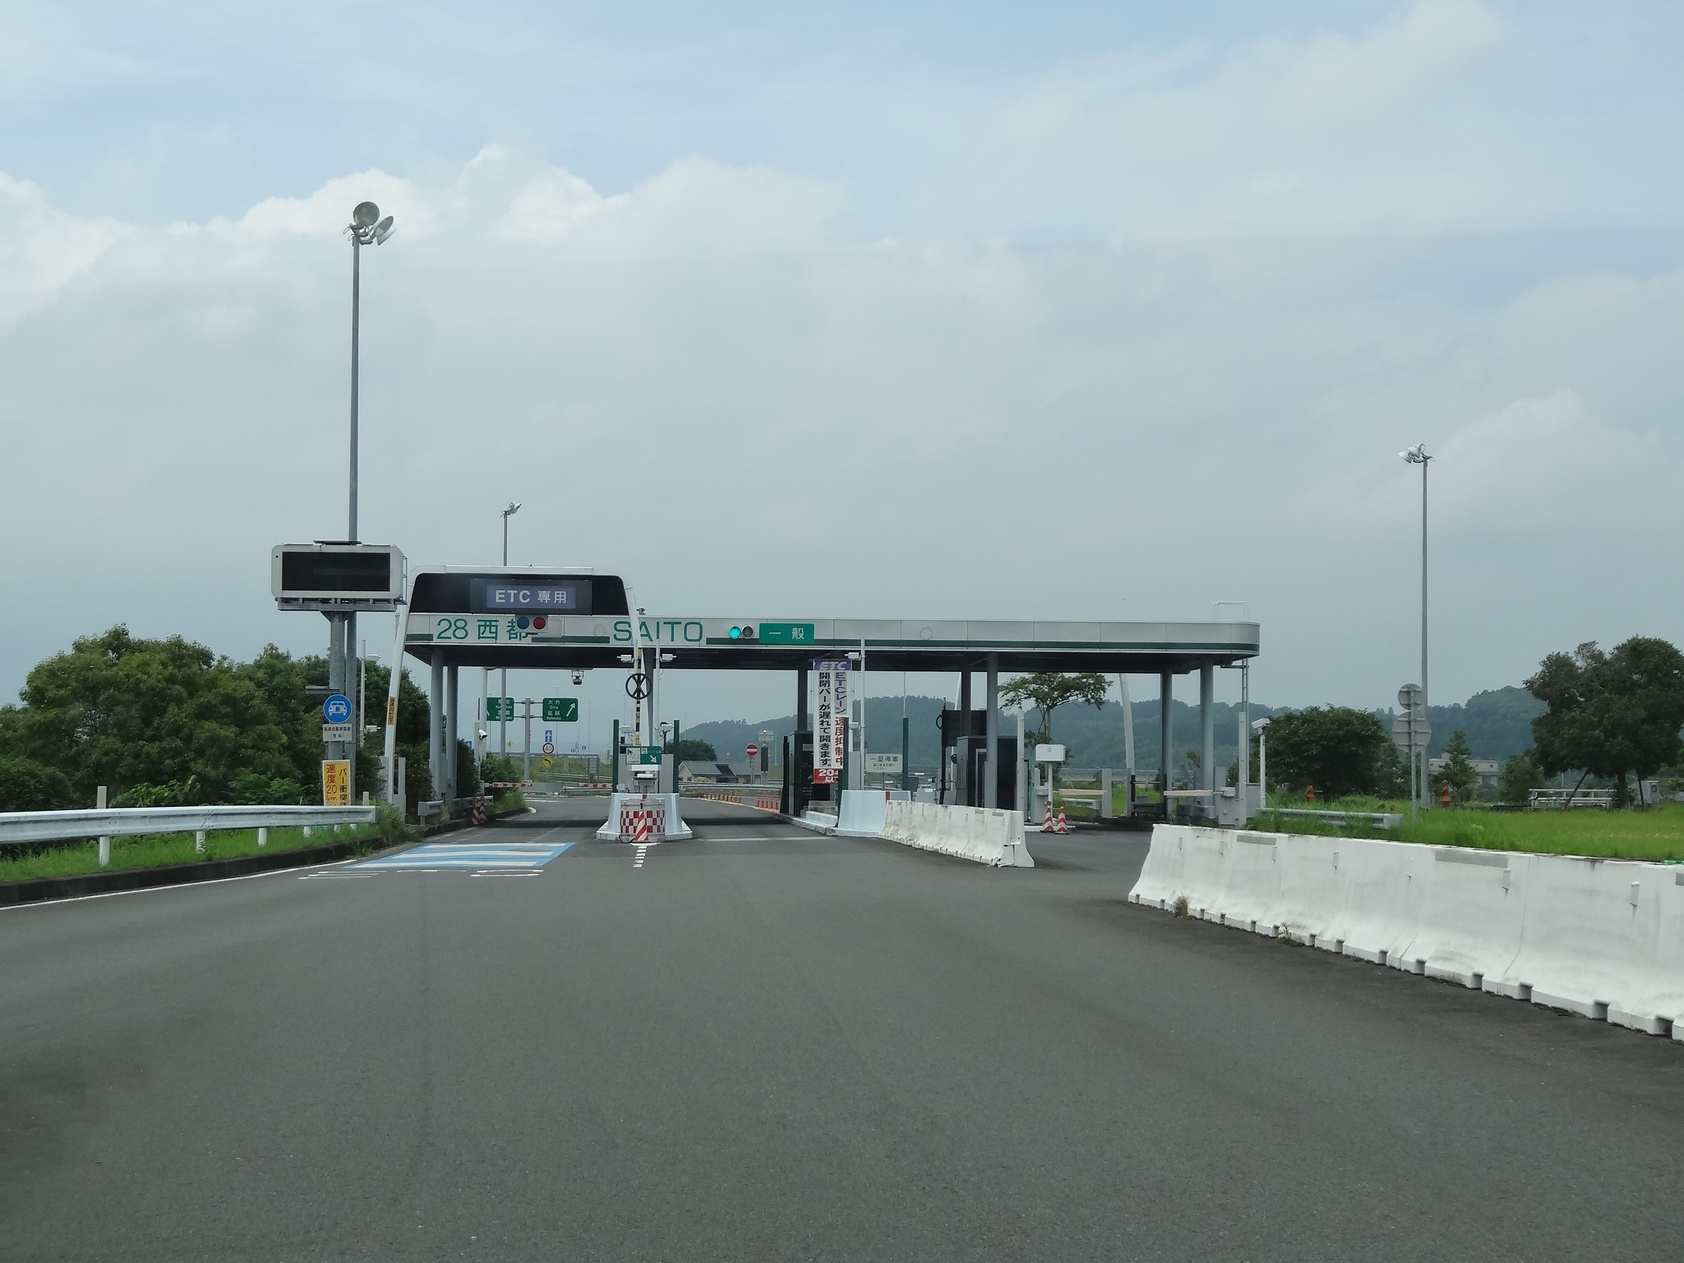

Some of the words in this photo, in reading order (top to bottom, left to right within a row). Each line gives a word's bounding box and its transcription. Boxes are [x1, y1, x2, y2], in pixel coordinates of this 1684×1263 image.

[495, 590, 531, 603] ETC
[537, 590, 567, 604] 専用
[437, 618, 468, 639] 28
[613, 621, 703, 642] SAITO
[768, 627, 805, 640] 一般
[819, 661, 847, 670] ETC
[819, 672, 831, 767] 開閉バーが遅れて開きます。
